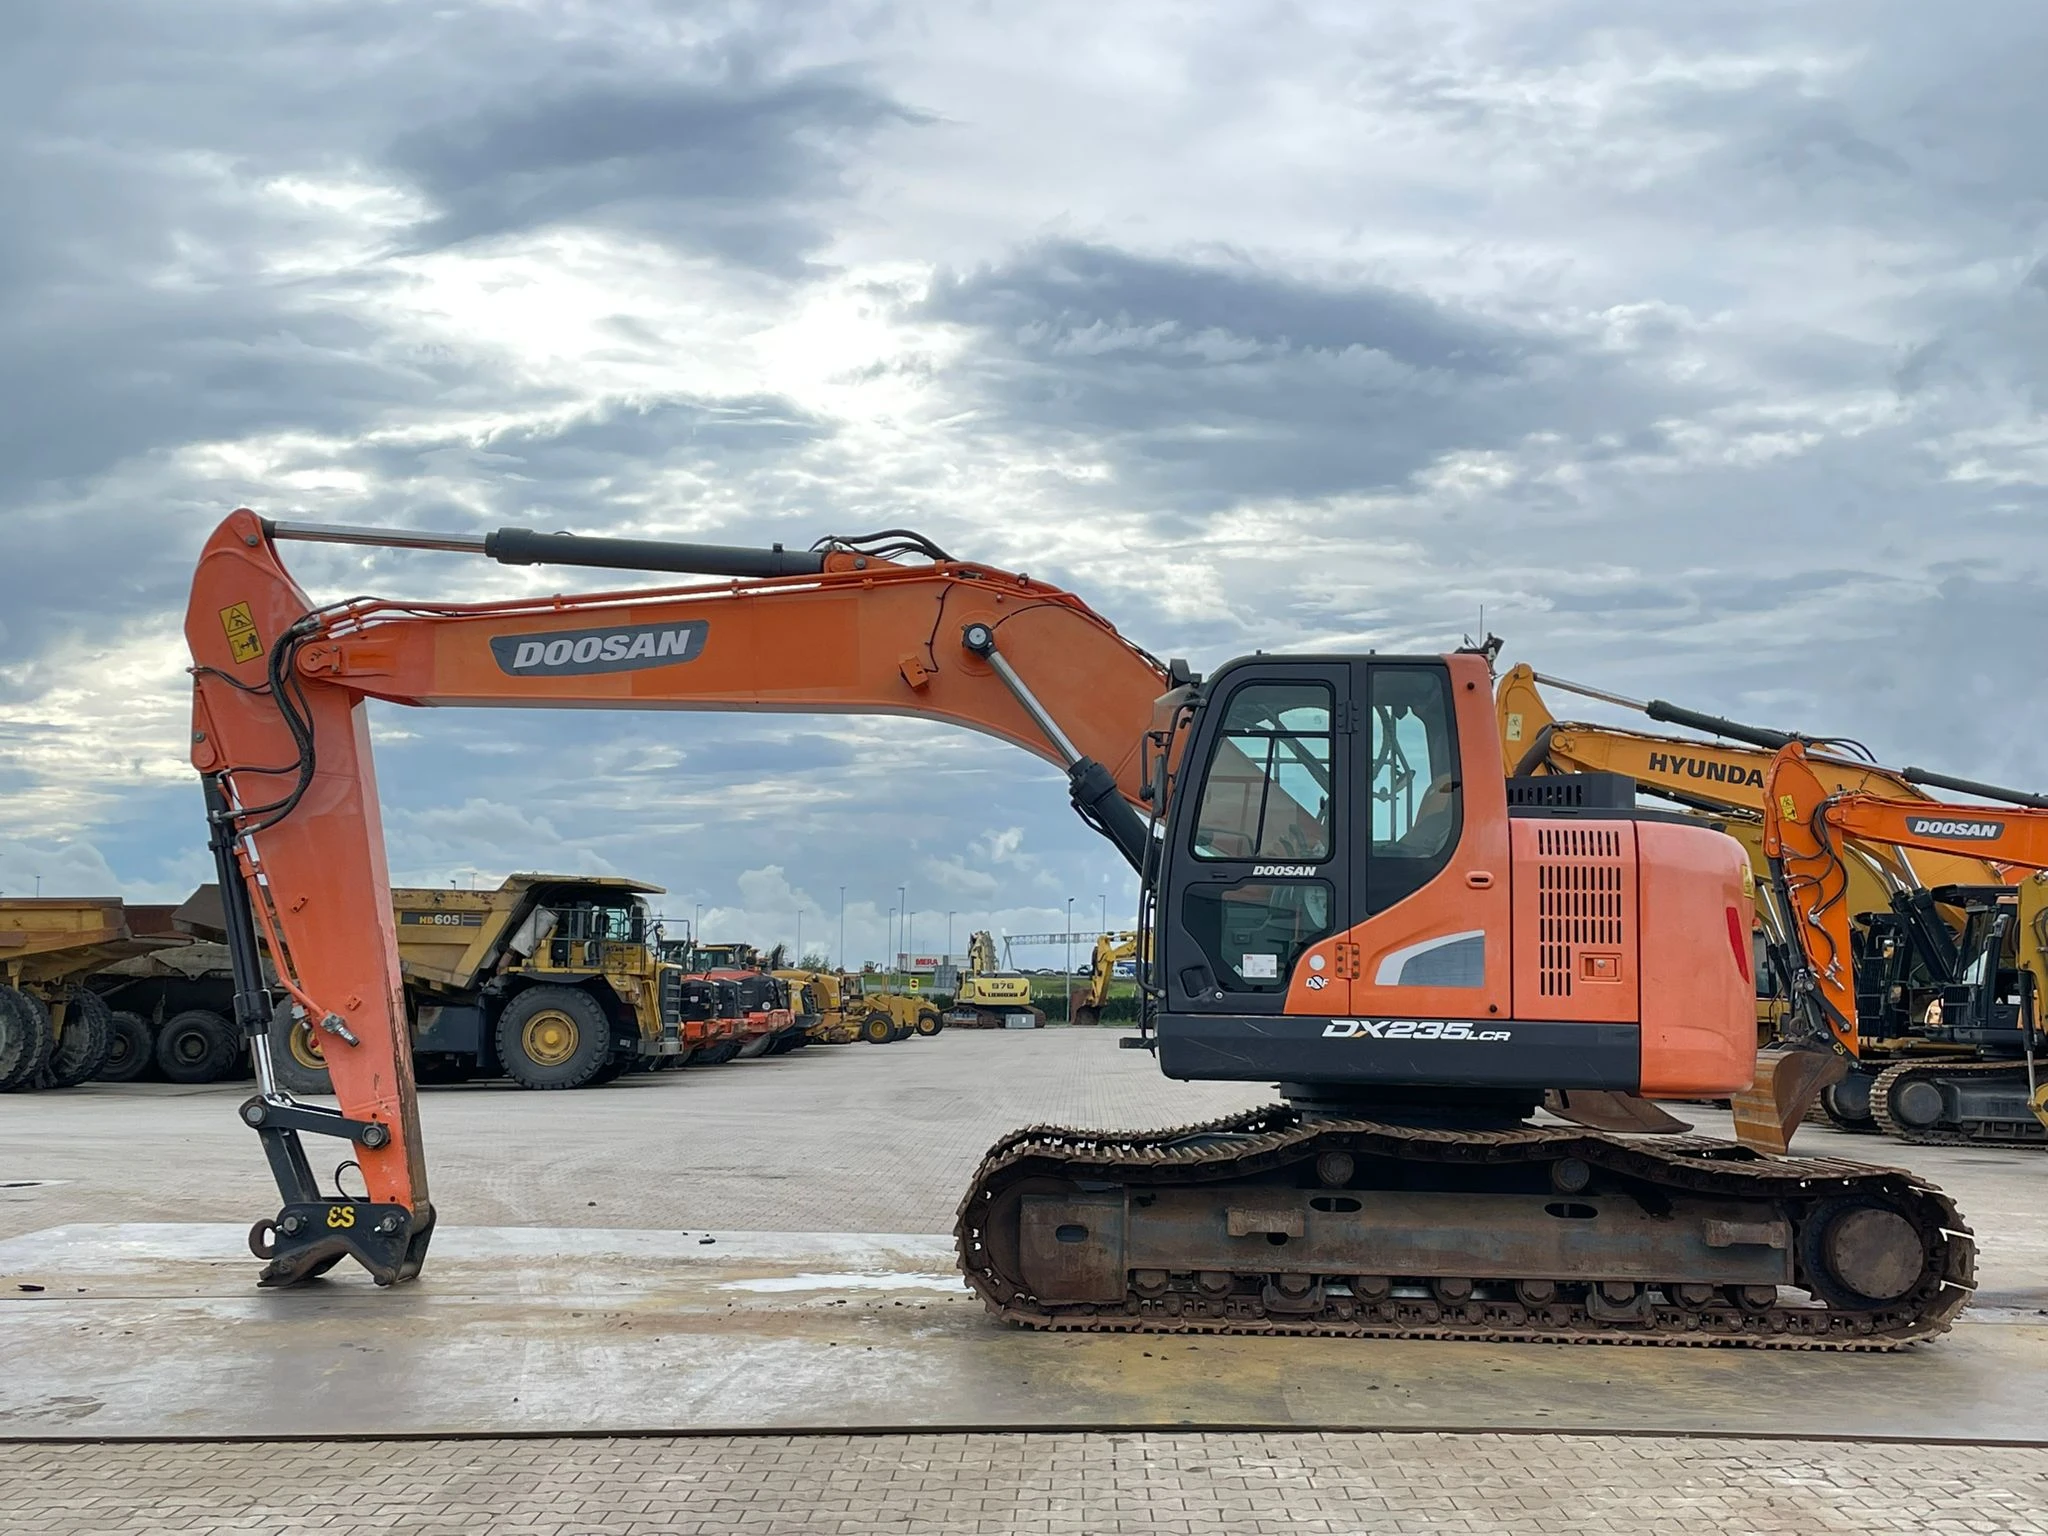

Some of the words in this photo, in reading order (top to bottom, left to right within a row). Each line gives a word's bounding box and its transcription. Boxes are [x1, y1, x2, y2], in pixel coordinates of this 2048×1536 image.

[513, 629, 691, 668] DOOSAN
[1649, 752, 1764, 789] HYUNDA
[1914, 820, 1997, 837] DOOSAN
[1252, 865, 1317, 876] DOOSAN
[419, 914, 460, 925] HD605
